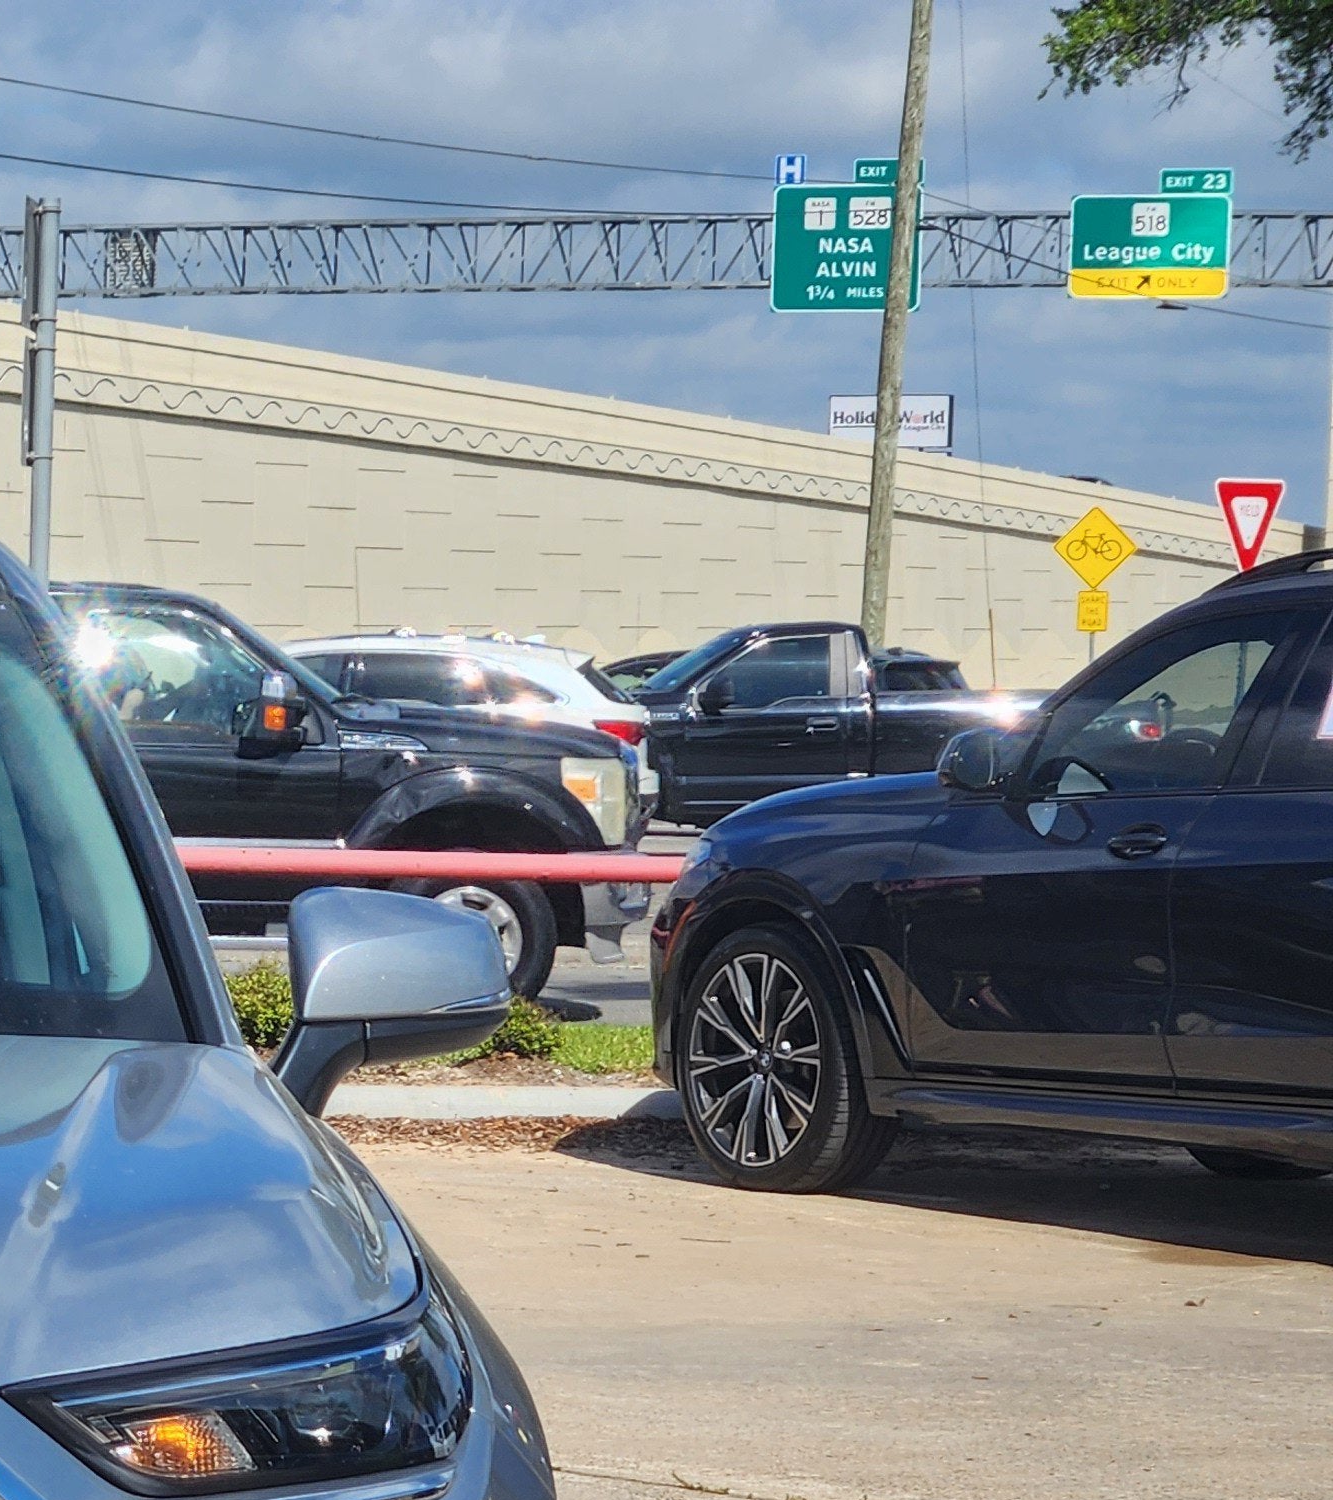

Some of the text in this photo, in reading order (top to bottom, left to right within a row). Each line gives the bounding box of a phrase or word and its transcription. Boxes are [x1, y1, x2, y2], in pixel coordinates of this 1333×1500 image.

[779, 157, 802, 183] H
[859, 166, 888, 177] EXIT
[1165, 173, 1227, 190] EXIT 23
[853, 210, 888, 226] 528
[1135, 215, 1166, 231] 518
[819, 237, 873, 253] NASA
[1084, 243, 1215, 264] League City
[816, 261, 877, 277] ALVIN
[1097, 277, 1199, 288] EXIT ONLY
[846, 287, 884, 298] MILES
[833, 411, 876, 424] Holid
